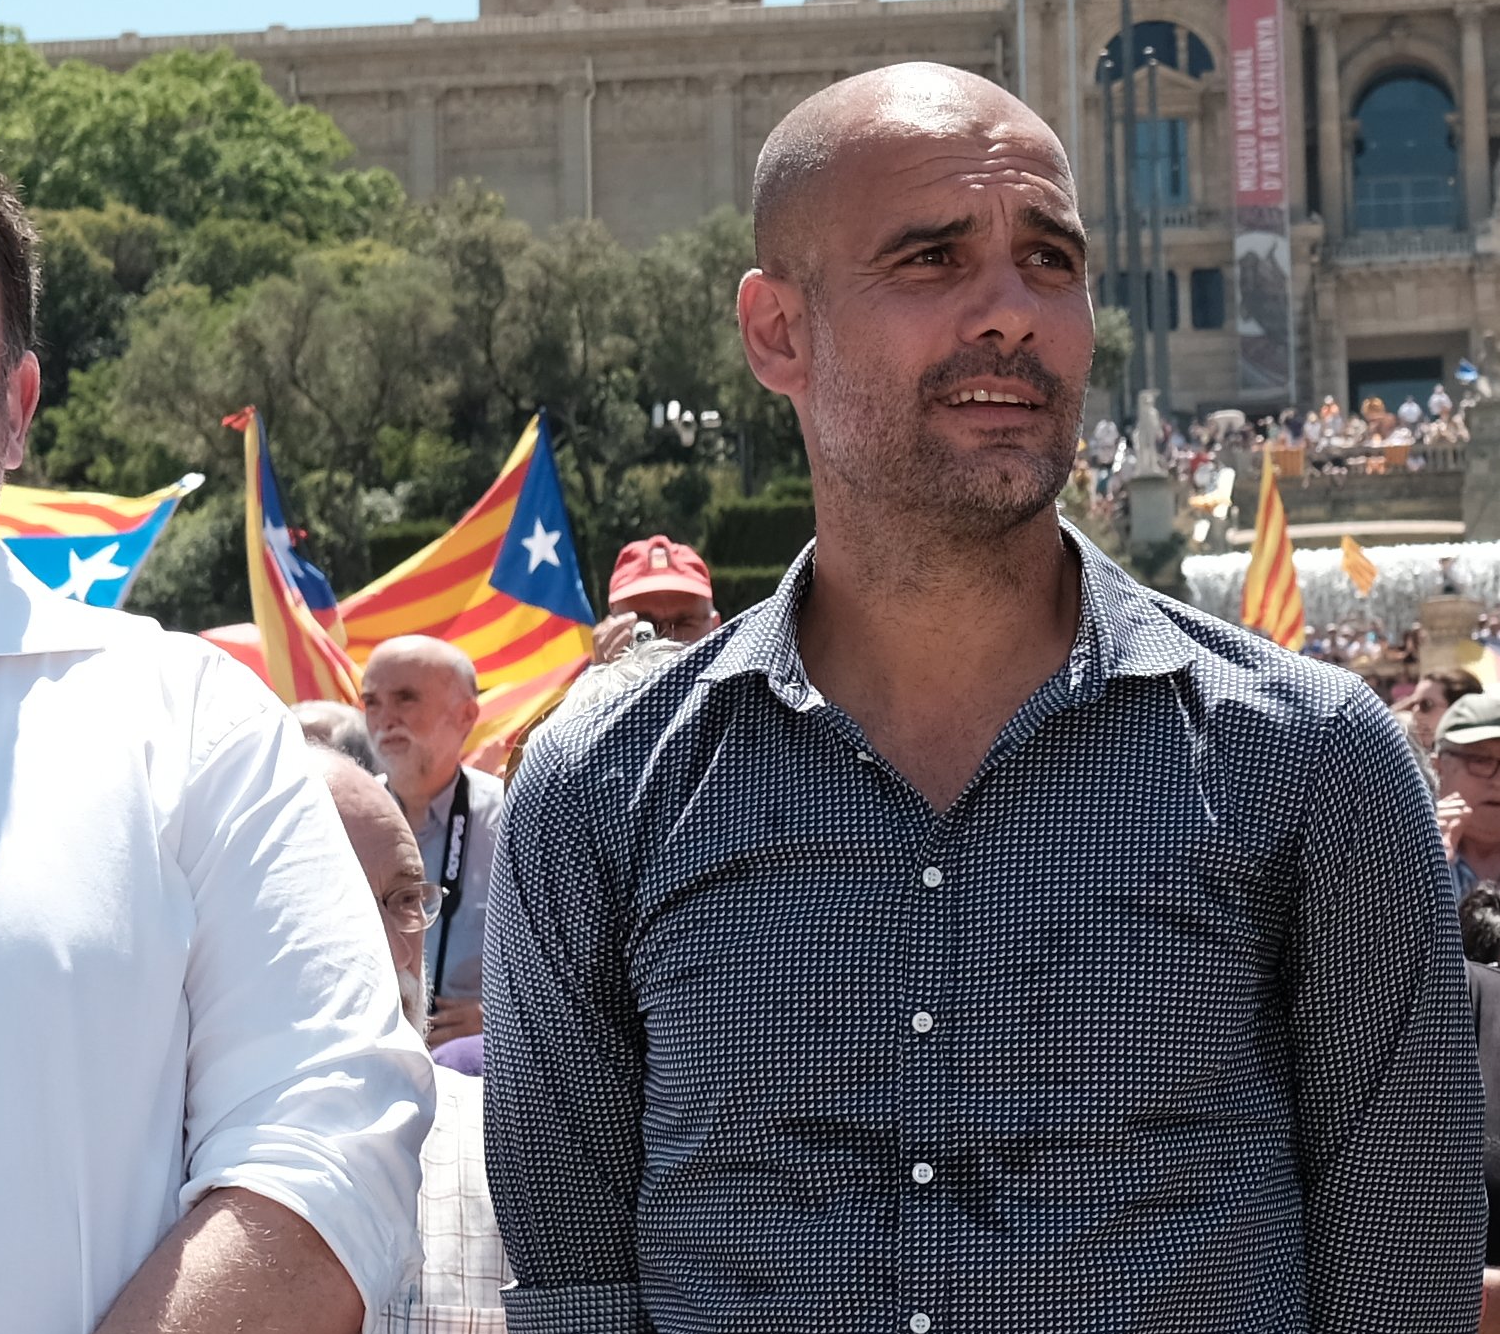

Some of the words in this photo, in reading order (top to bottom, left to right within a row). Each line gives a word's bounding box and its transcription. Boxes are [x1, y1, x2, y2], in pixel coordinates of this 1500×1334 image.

[1233, 48, 1256, 130] NACIONAL
[1255, 17, 1278, 110] CATALUNYA
[1257, 116, 1280, 137] DE
[1236, 134, 1258, 191] MUSEU
